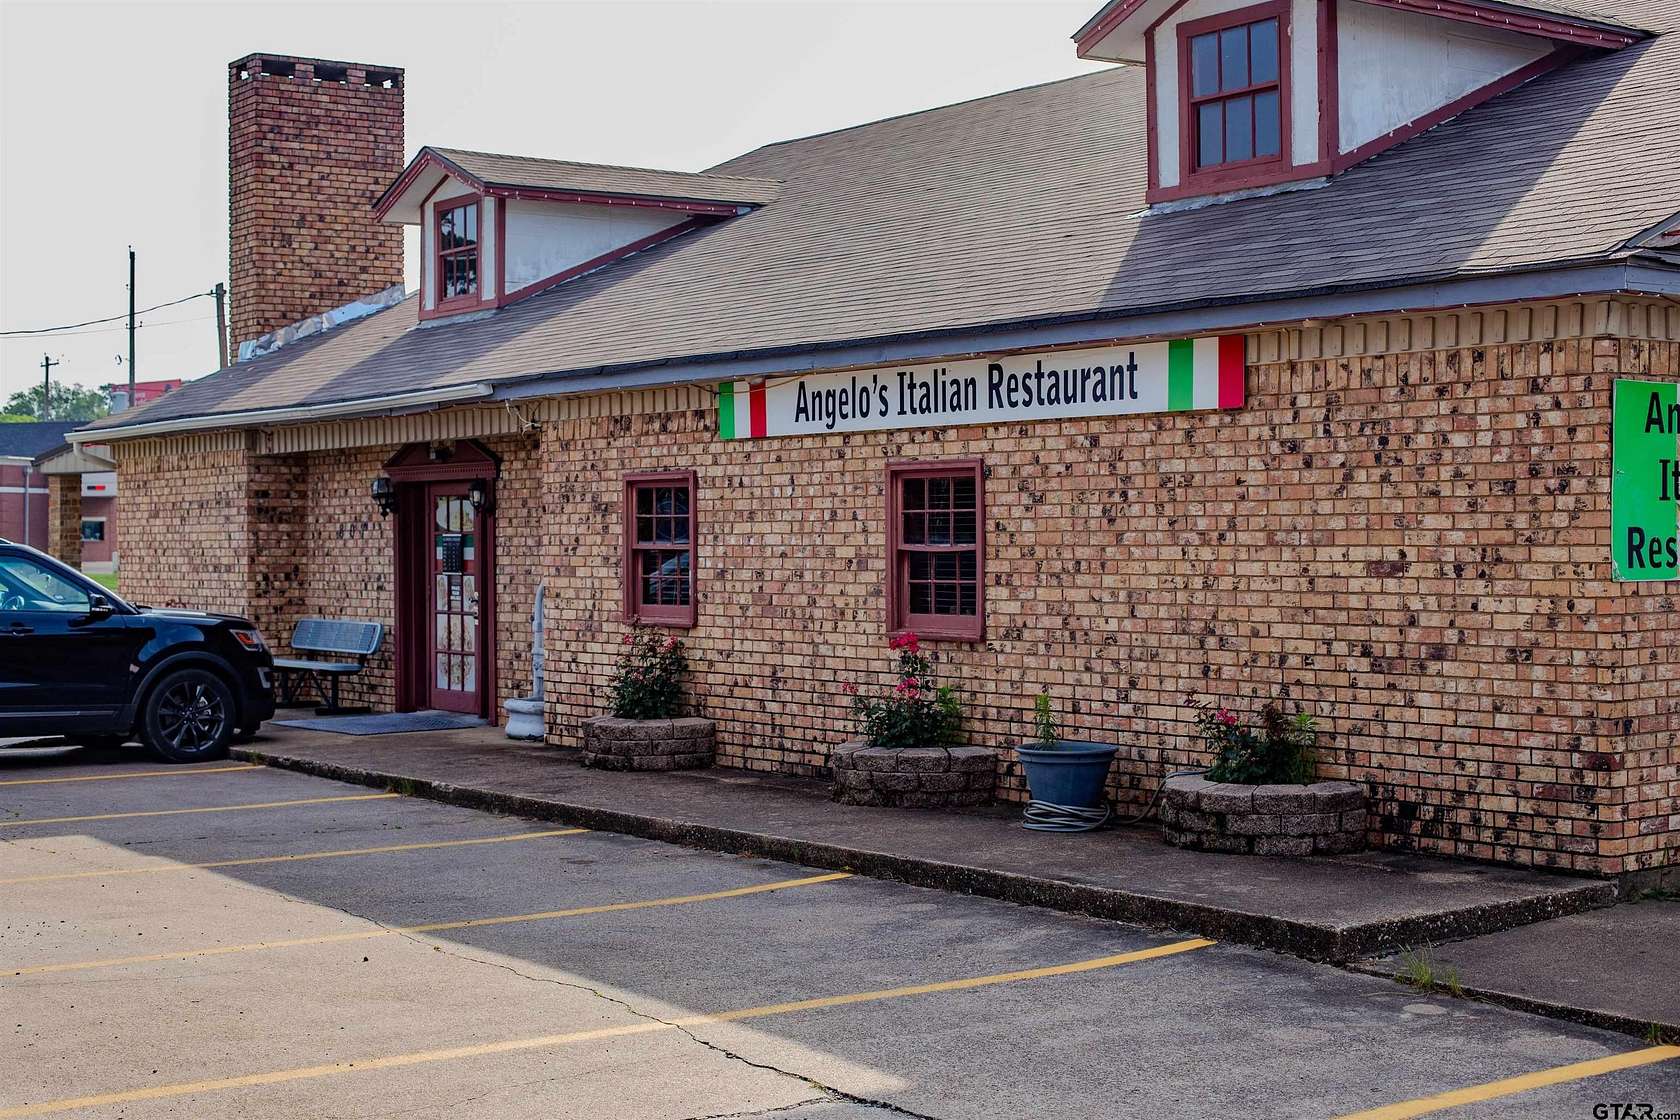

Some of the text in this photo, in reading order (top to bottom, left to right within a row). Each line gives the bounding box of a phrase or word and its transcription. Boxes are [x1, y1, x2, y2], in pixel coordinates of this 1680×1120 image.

[794, 351, 1138, 430] Angelo's Italian Restaurant
